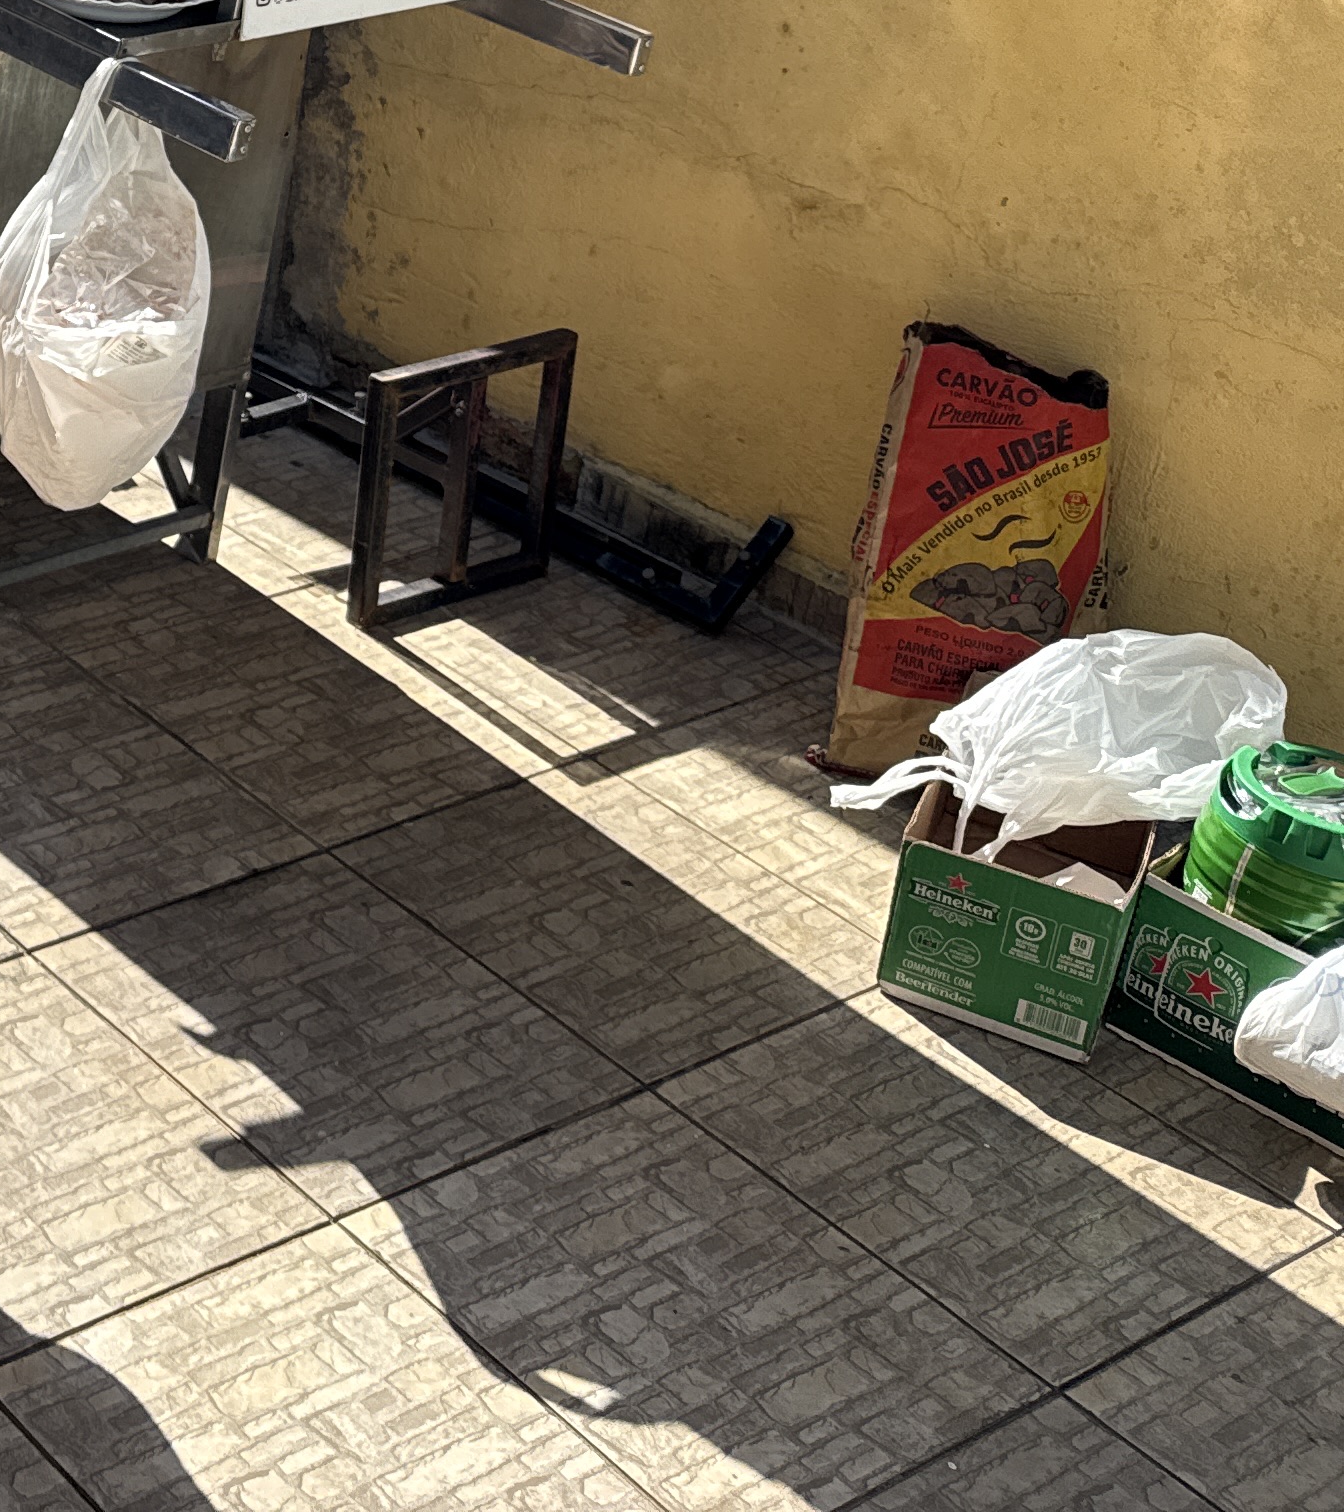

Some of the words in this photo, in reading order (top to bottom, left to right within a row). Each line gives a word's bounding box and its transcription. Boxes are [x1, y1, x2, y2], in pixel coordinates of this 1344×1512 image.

[935, 367, 1038, 407] CARVÃO
[938, 402, 1024, 428] Premium
[871, 422, 893, 491] CARVÃO
[926, 455, 996, 513] SÃO
[995, 418, 1074, 480] JOSÉ
[890, 553, 923, 585] Mais
[916, 511, 975, 555] Vendido
[974, 500, 993, 518] no
[992, 479, 1033, 508] Brasil
[1032, 461, 1070, 489] desde
[896, 638, 944, 661] CARVÃO
[914, 625, 949, 641] PESO
[894, 652, 924, 670] PARA
[913, 881, 994, 920] Heineken
[1073, 937, 1088, 950] 30
[902, 958, 951, 983] COMPATÍVEL
[953, 975, 973, 991] COM
